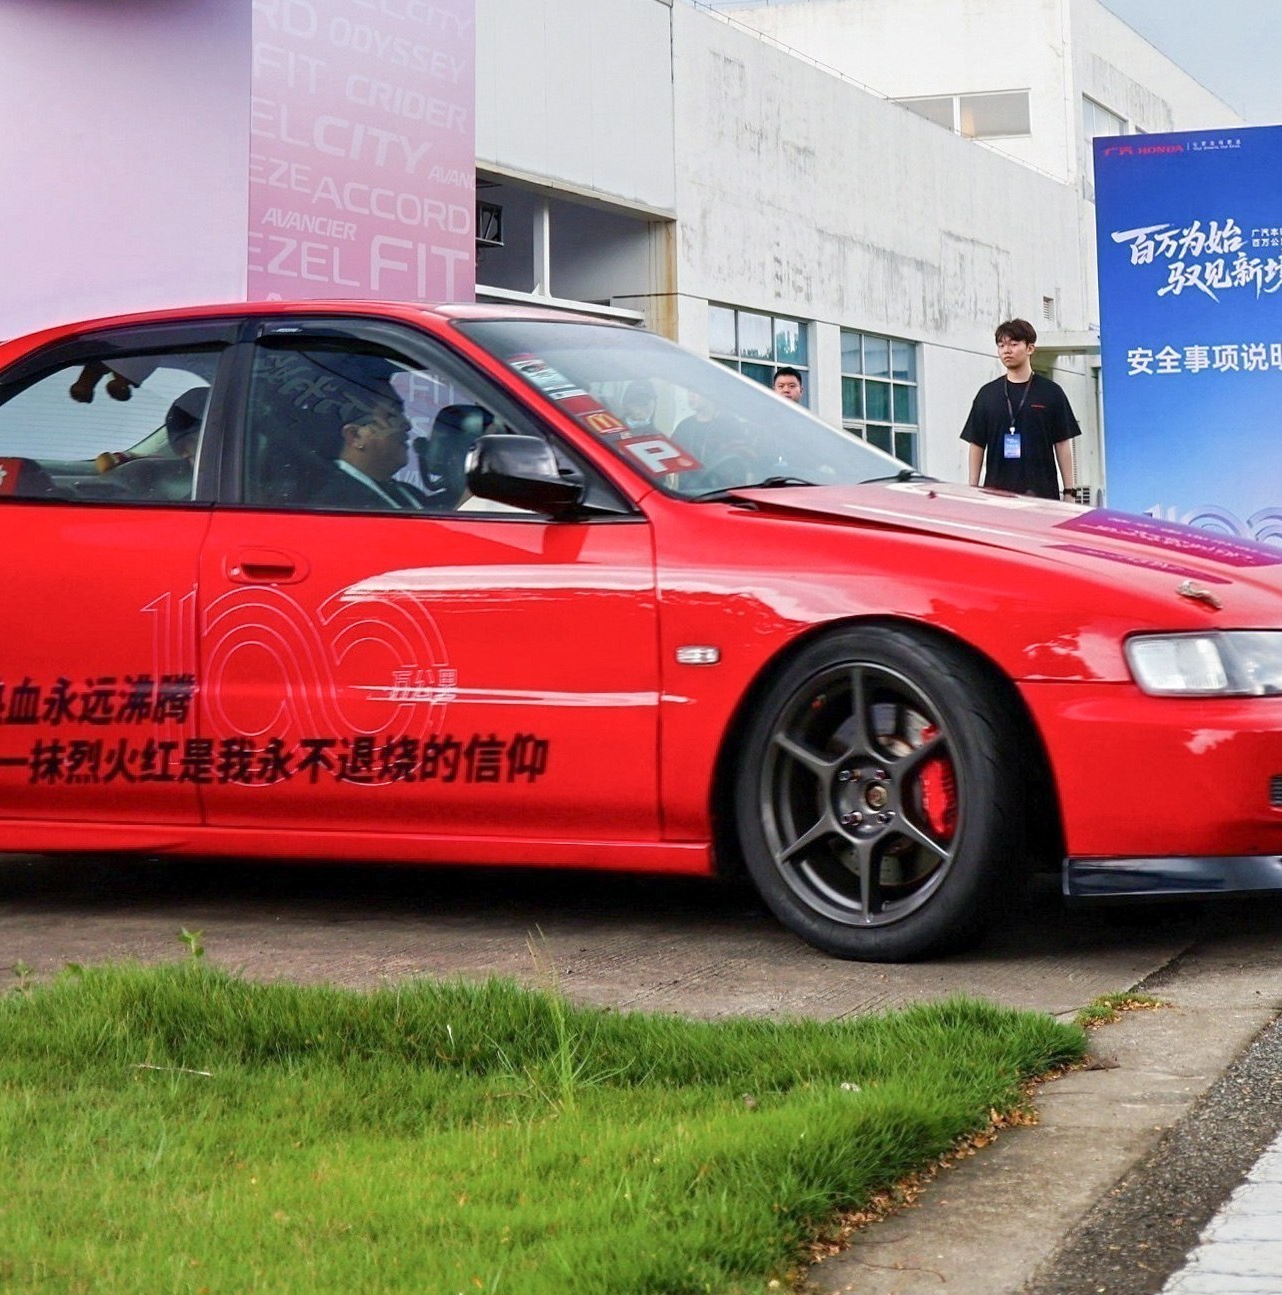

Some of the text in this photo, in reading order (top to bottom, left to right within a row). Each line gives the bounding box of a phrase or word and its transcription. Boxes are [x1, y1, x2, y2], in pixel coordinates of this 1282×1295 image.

[314, 114, 433, 175] CITY
[261, 206, 357, 242] AVANCIER
[311, 176, 471, 235] ACCORD
[369, 234, 471, 303] FIT
[1111, 218, 1248, 265] 百万为始
